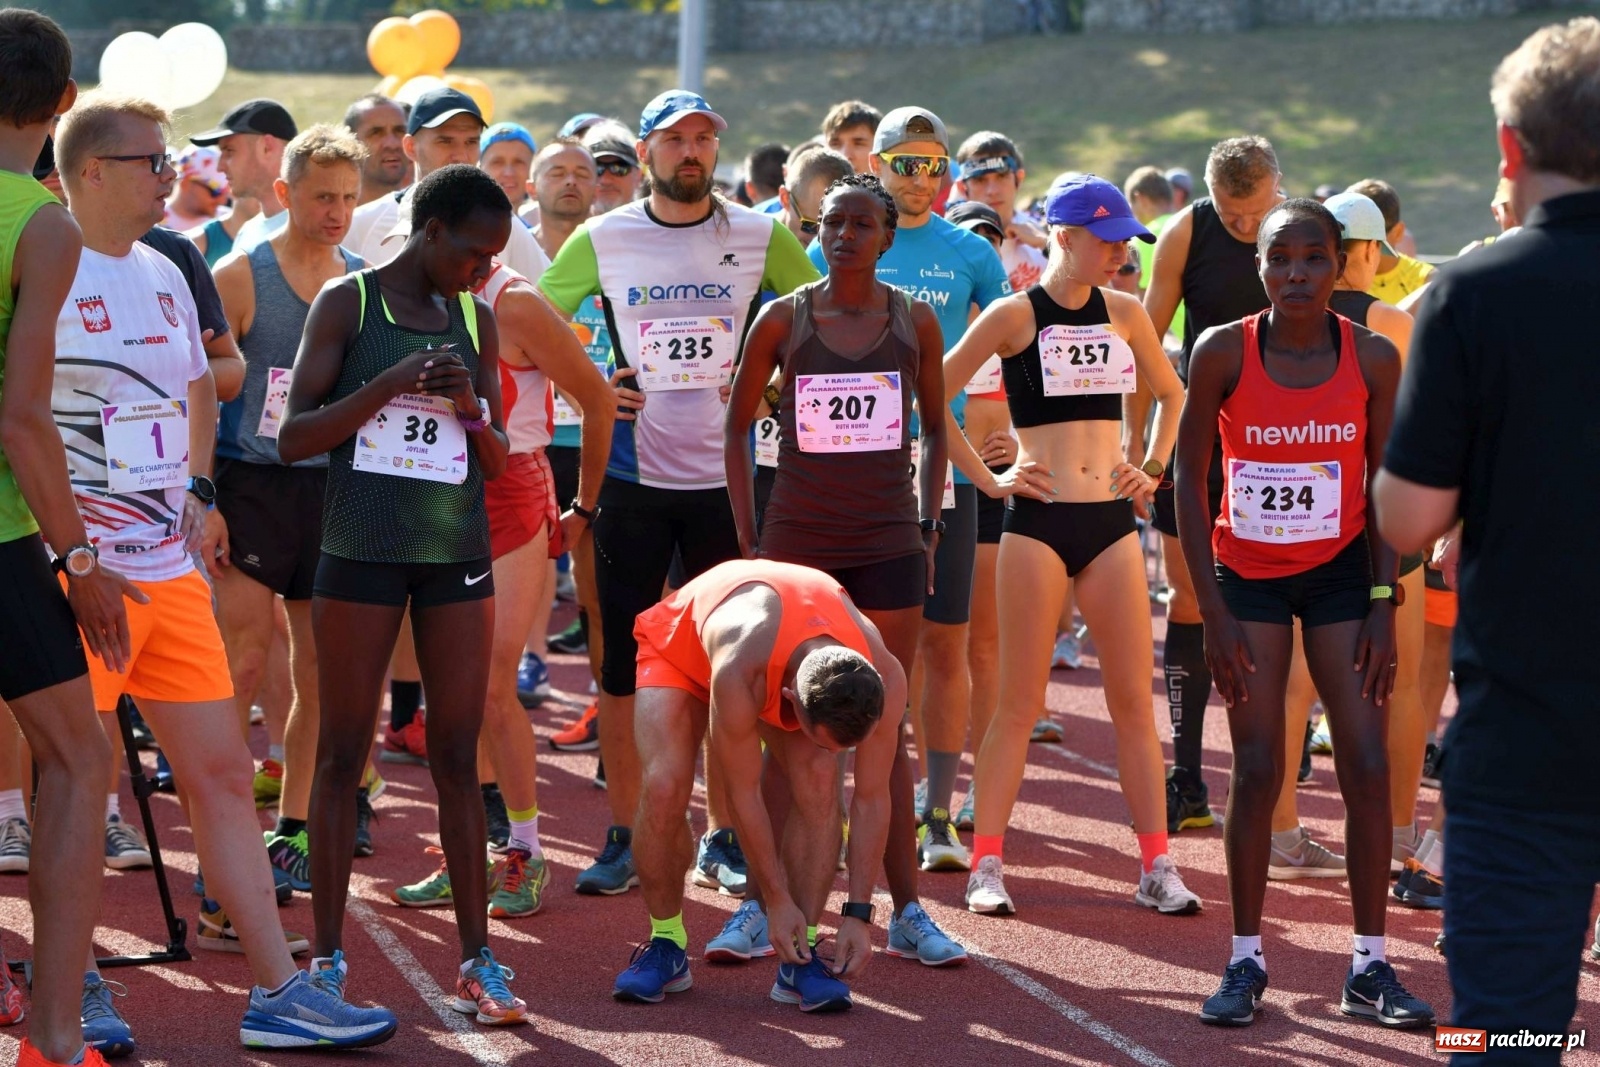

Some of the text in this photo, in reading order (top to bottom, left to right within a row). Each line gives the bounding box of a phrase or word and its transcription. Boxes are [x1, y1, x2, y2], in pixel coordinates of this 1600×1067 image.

[75, 295, 103, 304] POLSKA
[667, 336, 713, 360] 235
[1067, 343, 1110, 366] 257
[402, 394, 434, 404] RAFAKO
[828, 394, 877, 421] 207
[150, 422, 165, 459] 1
[403, 415, 439, 446] 38
[1245, 420, 1357, 446] newline
[406, 445, 429, 455] JOYLINE
[129, 465, 145, 475] BIEG
[1260, 485, 1315, 511] 234
[1260, 513, 1289, 521] CHRISTINE
